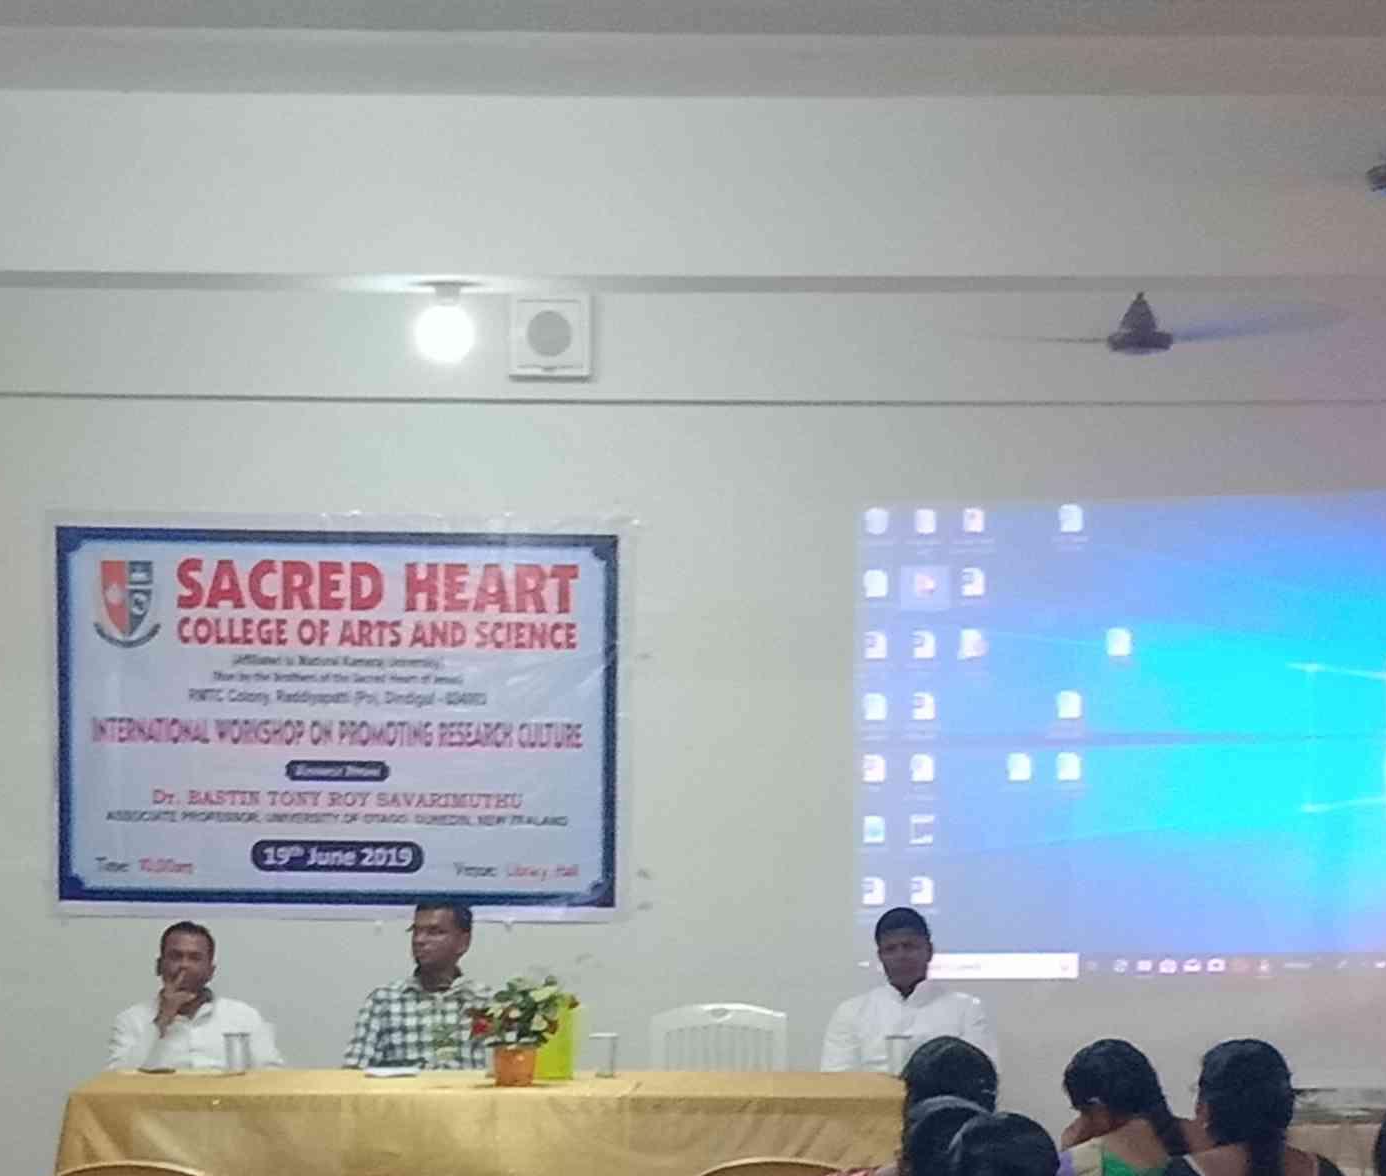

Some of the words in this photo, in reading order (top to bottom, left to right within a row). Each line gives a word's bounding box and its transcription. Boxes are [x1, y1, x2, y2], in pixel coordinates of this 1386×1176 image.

[176, 558, 384, 612] SACRED
[404, 562, 580, 614] HEART
[177, 616, 288, 646] COLLEGE
[297, 618, 330, 646] OF
[339, 619, 402, 648] ARTS
[410, 621, 467, 648] AND
[476, 621, 577, 650] SCIENCE
[92, 717, 210, 744] INTERNATIONAL
[215, 719, 304, 745] WORKSHOP
[311, 720, 333, 745] ON
[338, 720, 433, 748] PROMOTING
[438, 721, 513, 748] RESEARCH
[518, 722, 583, 749] CULTURE
[151, 789, 180, 805] Dr.
[187, 790, 261, 806] BASTIN
[266, 791, 321, 807] TONY
[327, 792, 371, 808] ROY
[262, 845, 305, 866] 19th
[306, 847, 357, 867] June
[360, 847, 413, 867] 2019
